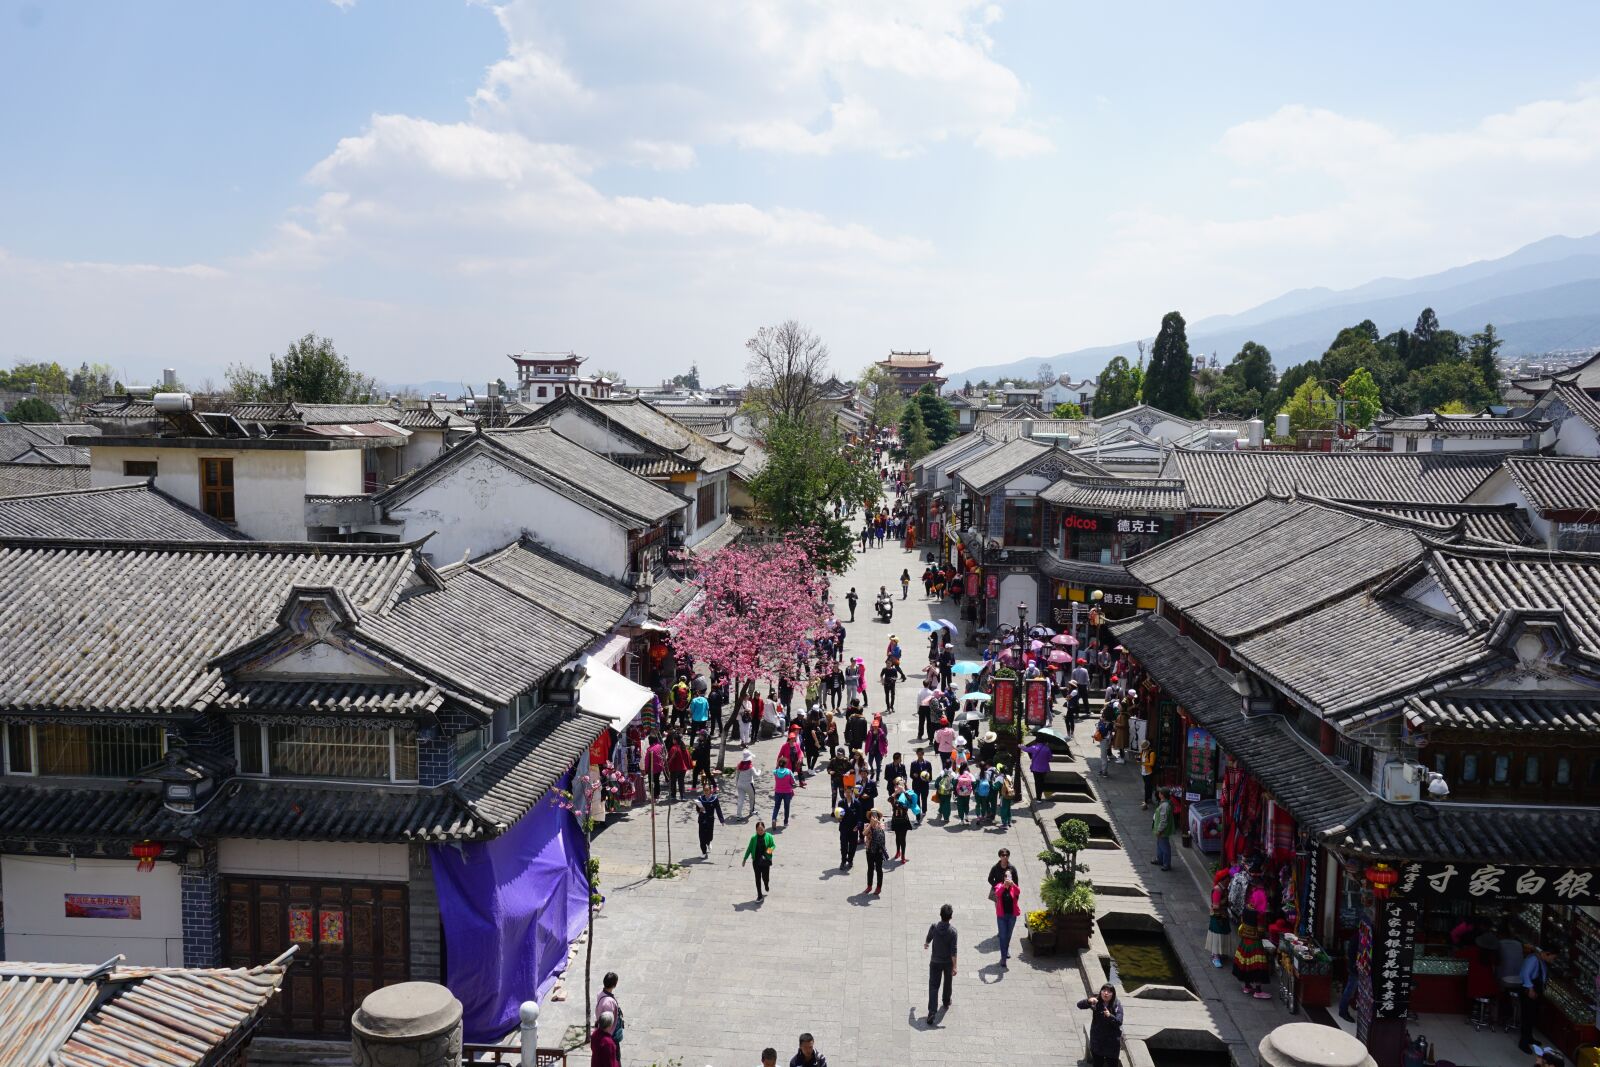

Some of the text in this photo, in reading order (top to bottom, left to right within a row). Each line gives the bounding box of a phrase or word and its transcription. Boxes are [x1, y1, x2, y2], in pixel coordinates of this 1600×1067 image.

[1065, 515, 1097, 530] dicos
[1117, 519, 1159, 533] 德克士
[1104, 593, 1134, 605] 德克士
[1400, 863, 1422, 893] 老字号
[1427, 864, 1600, 899] 寸家白银
